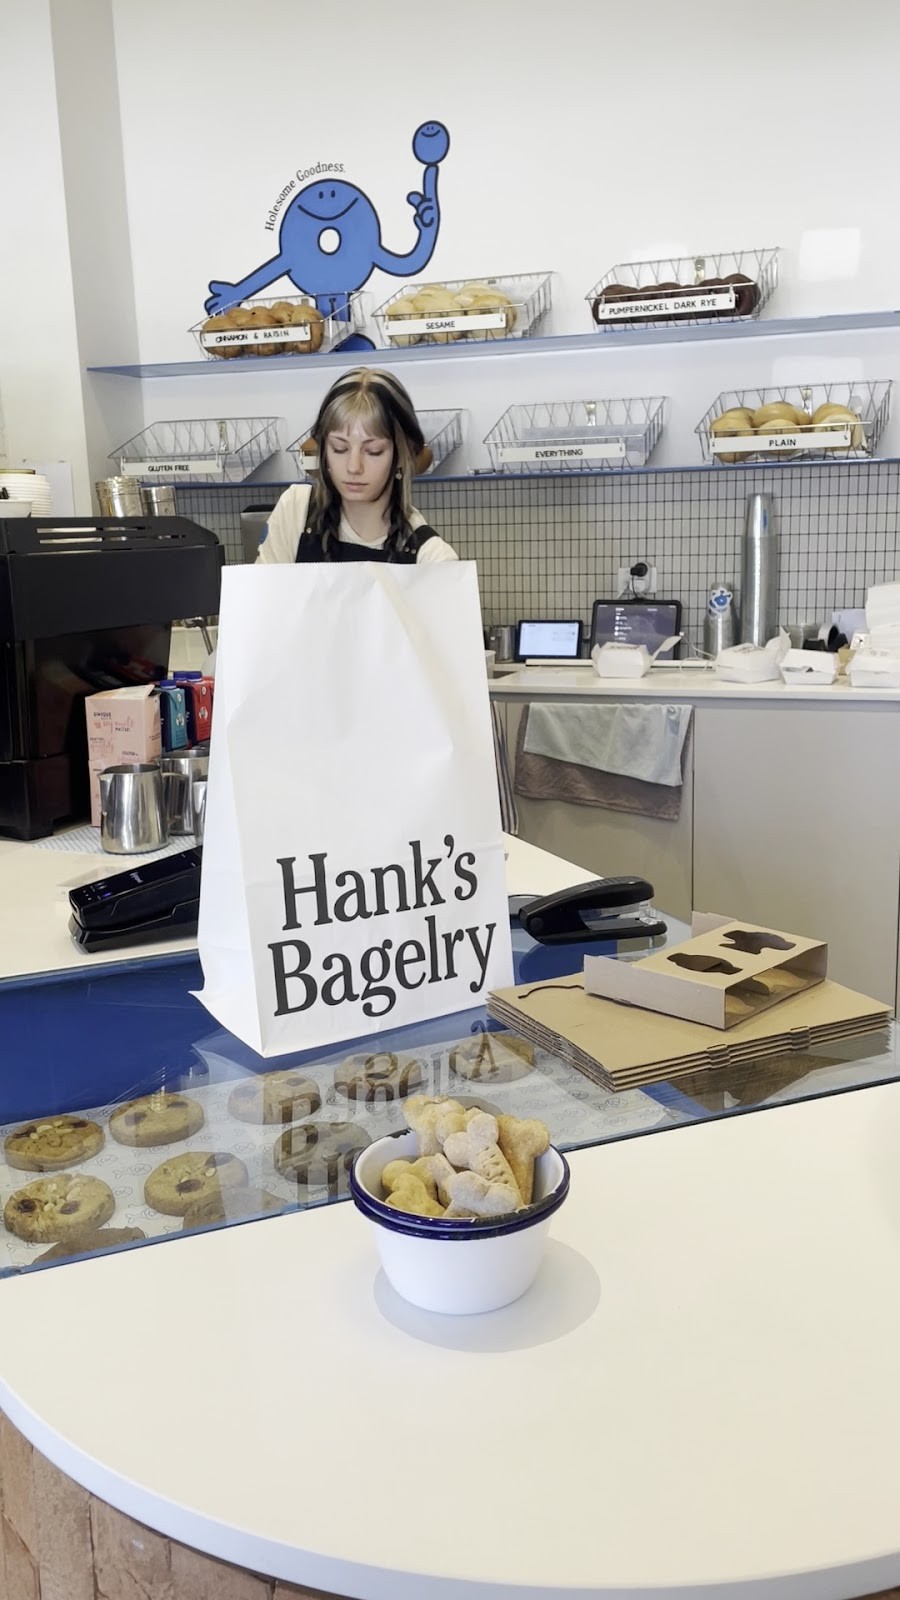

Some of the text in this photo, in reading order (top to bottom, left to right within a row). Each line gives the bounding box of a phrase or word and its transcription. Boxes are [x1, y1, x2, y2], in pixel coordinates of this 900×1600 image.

[264, 180, 296, 231] Holesome
[609, 299, 717, 315] PUMPERNICKEL DARK RYE
[426, 320, 456, 330] SESAME
[263, 330, 289, 338] RAISIN
[769, 438, 797, 447] PLAIN
[535, 448, 583, 458] EVERYTHING
[276, 834, 478, 931] Hank's
[267, 915, 497, 1017] Bagelry
